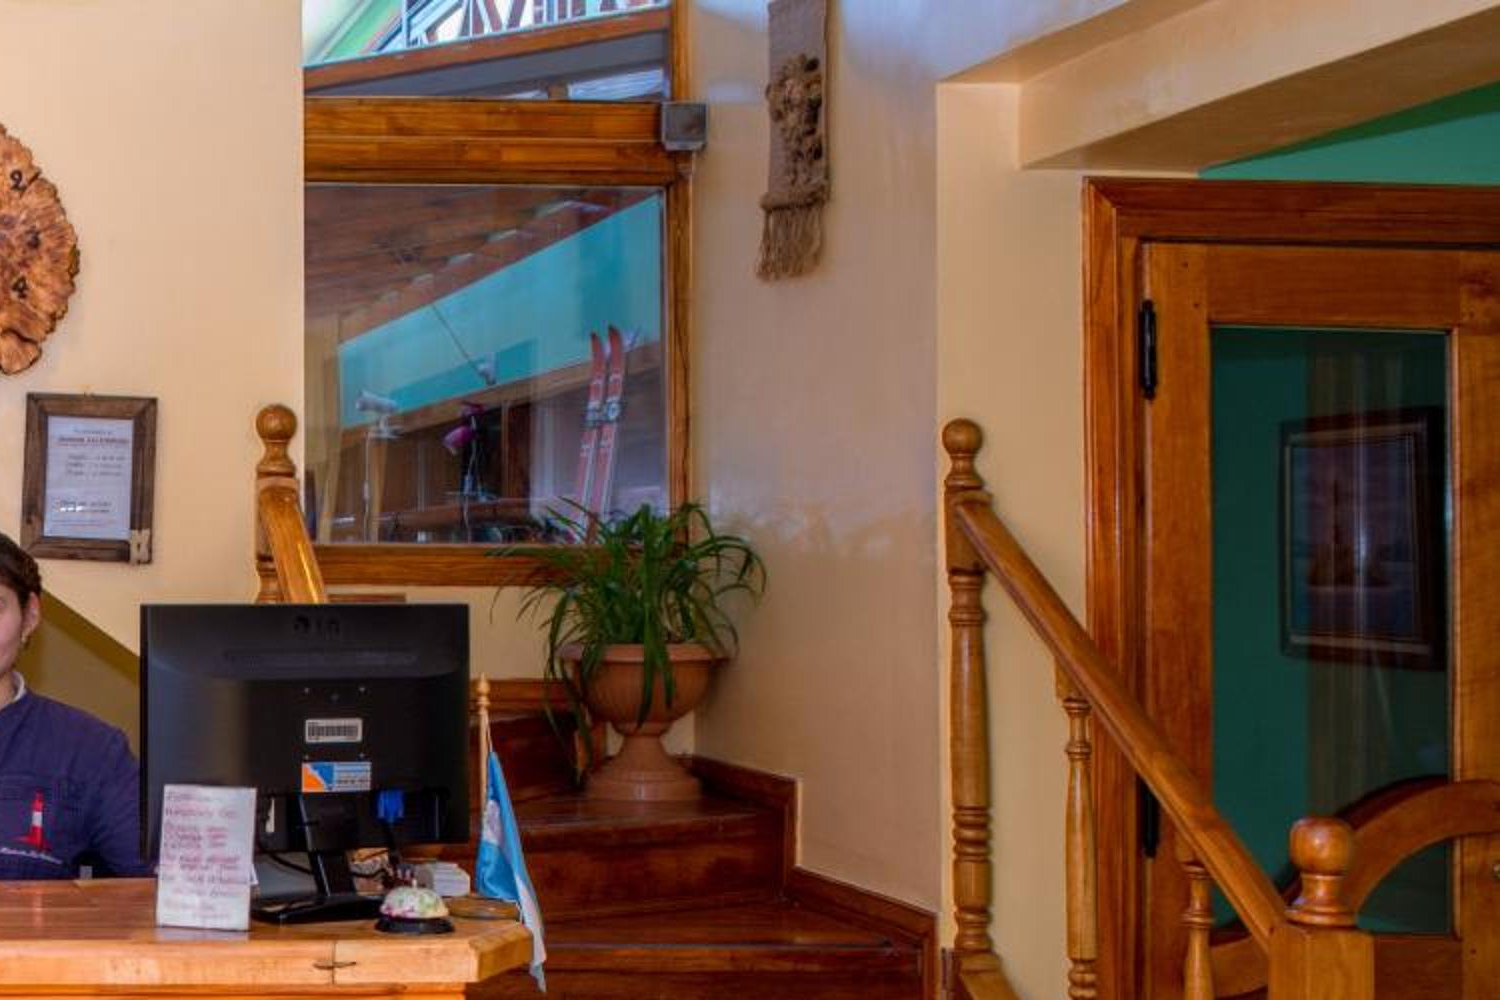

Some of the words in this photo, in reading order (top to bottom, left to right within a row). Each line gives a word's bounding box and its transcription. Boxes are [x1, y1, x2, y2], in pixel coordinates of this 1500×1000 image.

[9, 169, 27, 192] 2
[25, 225, 41, 250] 3
[11, 275, 29, 299] 4
